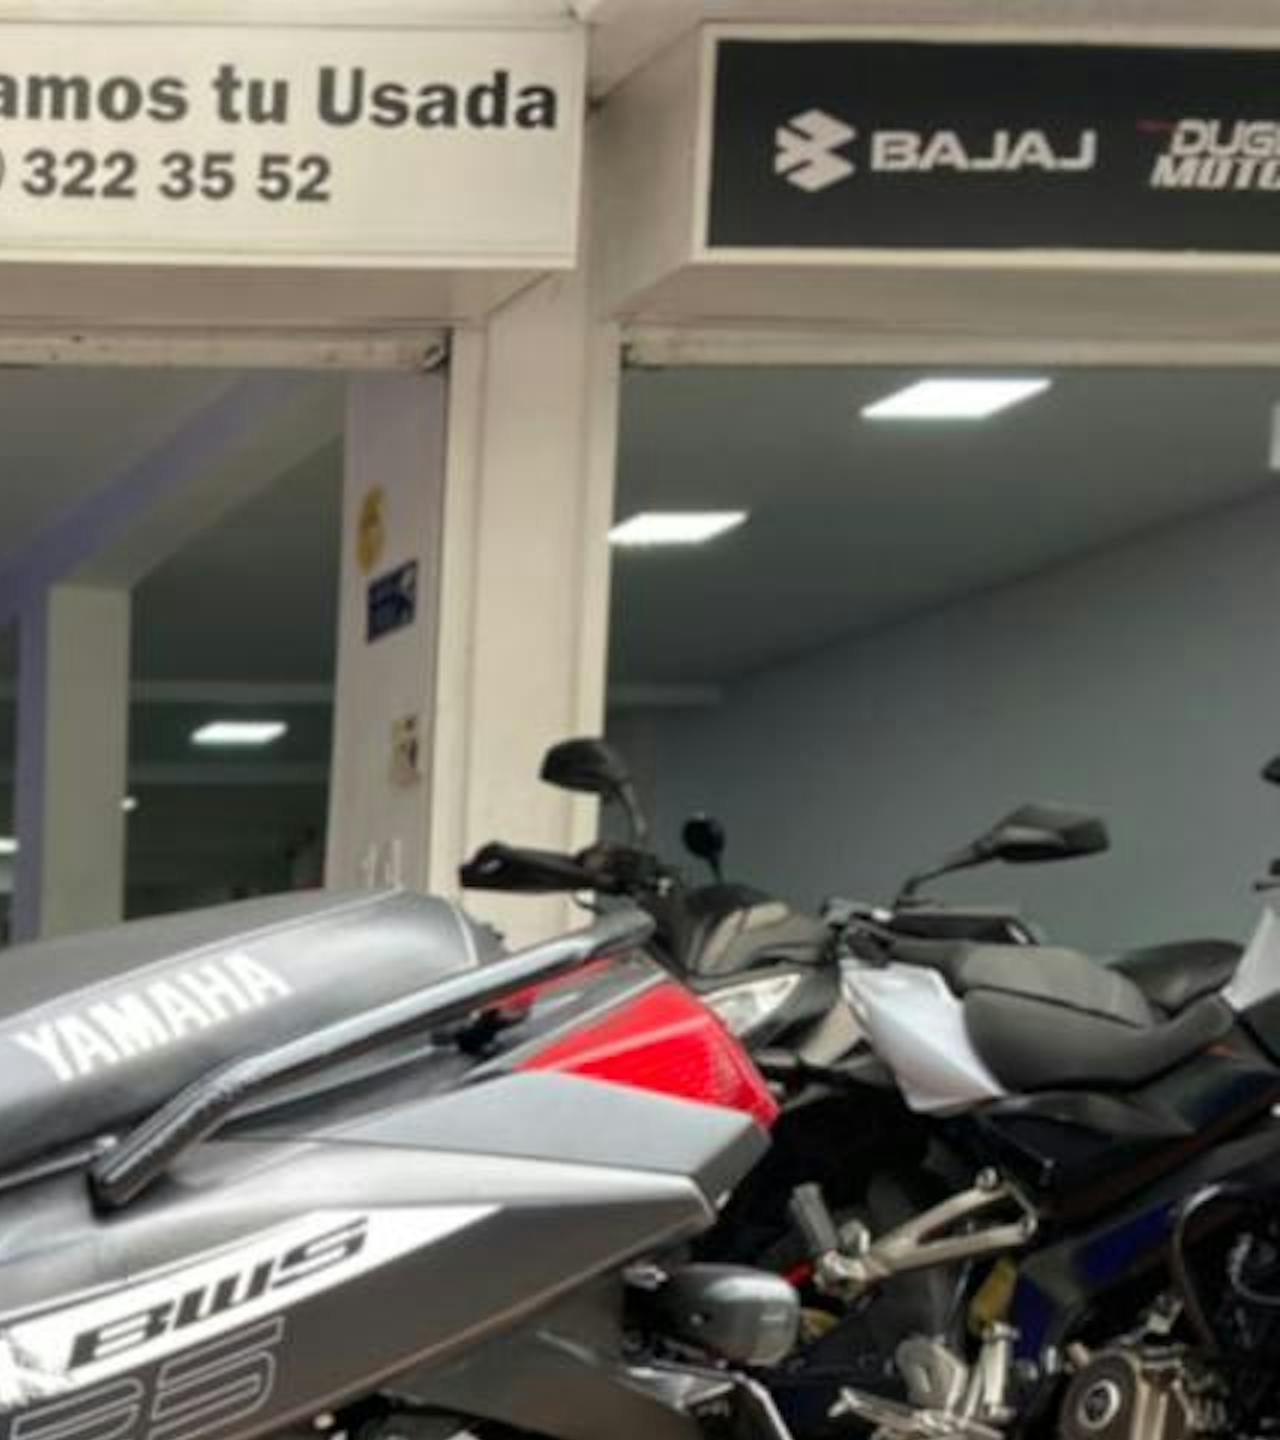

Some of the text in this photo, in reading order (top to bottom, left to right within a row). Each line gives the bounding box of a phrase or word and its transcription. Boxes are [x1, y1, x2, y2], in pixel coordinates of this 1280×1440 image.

[213, 64, 289, 126] tu
[317, 66, 558, 130] Usada
[870, 130, 1098, 171] BAJAJ
[1171, 119, 1280, 156] DUG
[20, 148, 332, 203] 322 35 52
[13, 951, 296, 1082] YAMAHA
